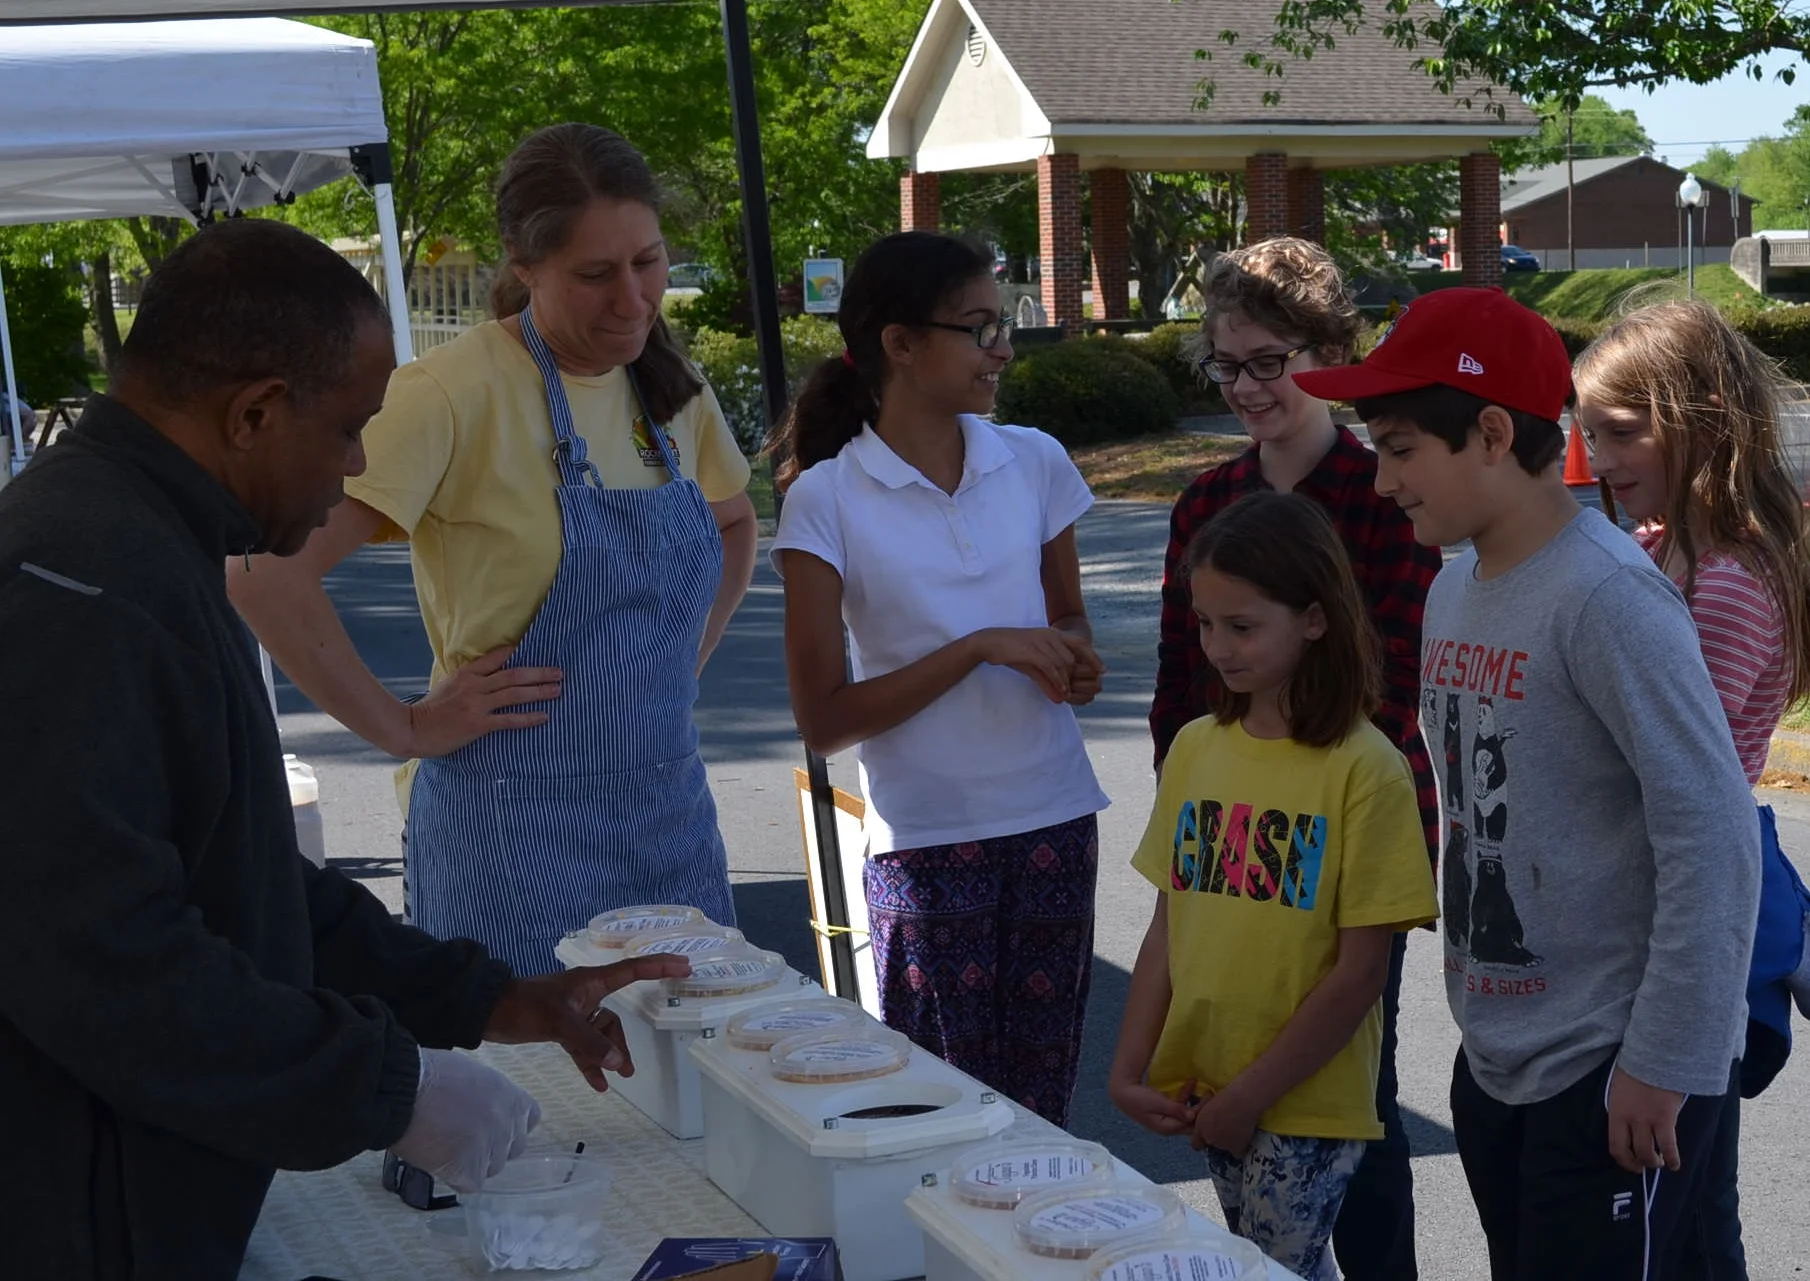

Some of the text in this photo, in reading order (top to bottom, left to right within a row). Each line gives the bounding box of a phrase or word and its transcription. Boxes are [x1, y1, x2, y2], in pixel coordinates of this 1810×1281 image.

[1171, 799, 1328, 911] CRASH
[1480, 976, 1495, 995] &
[1498, 977, 1547, 995] SIZES
